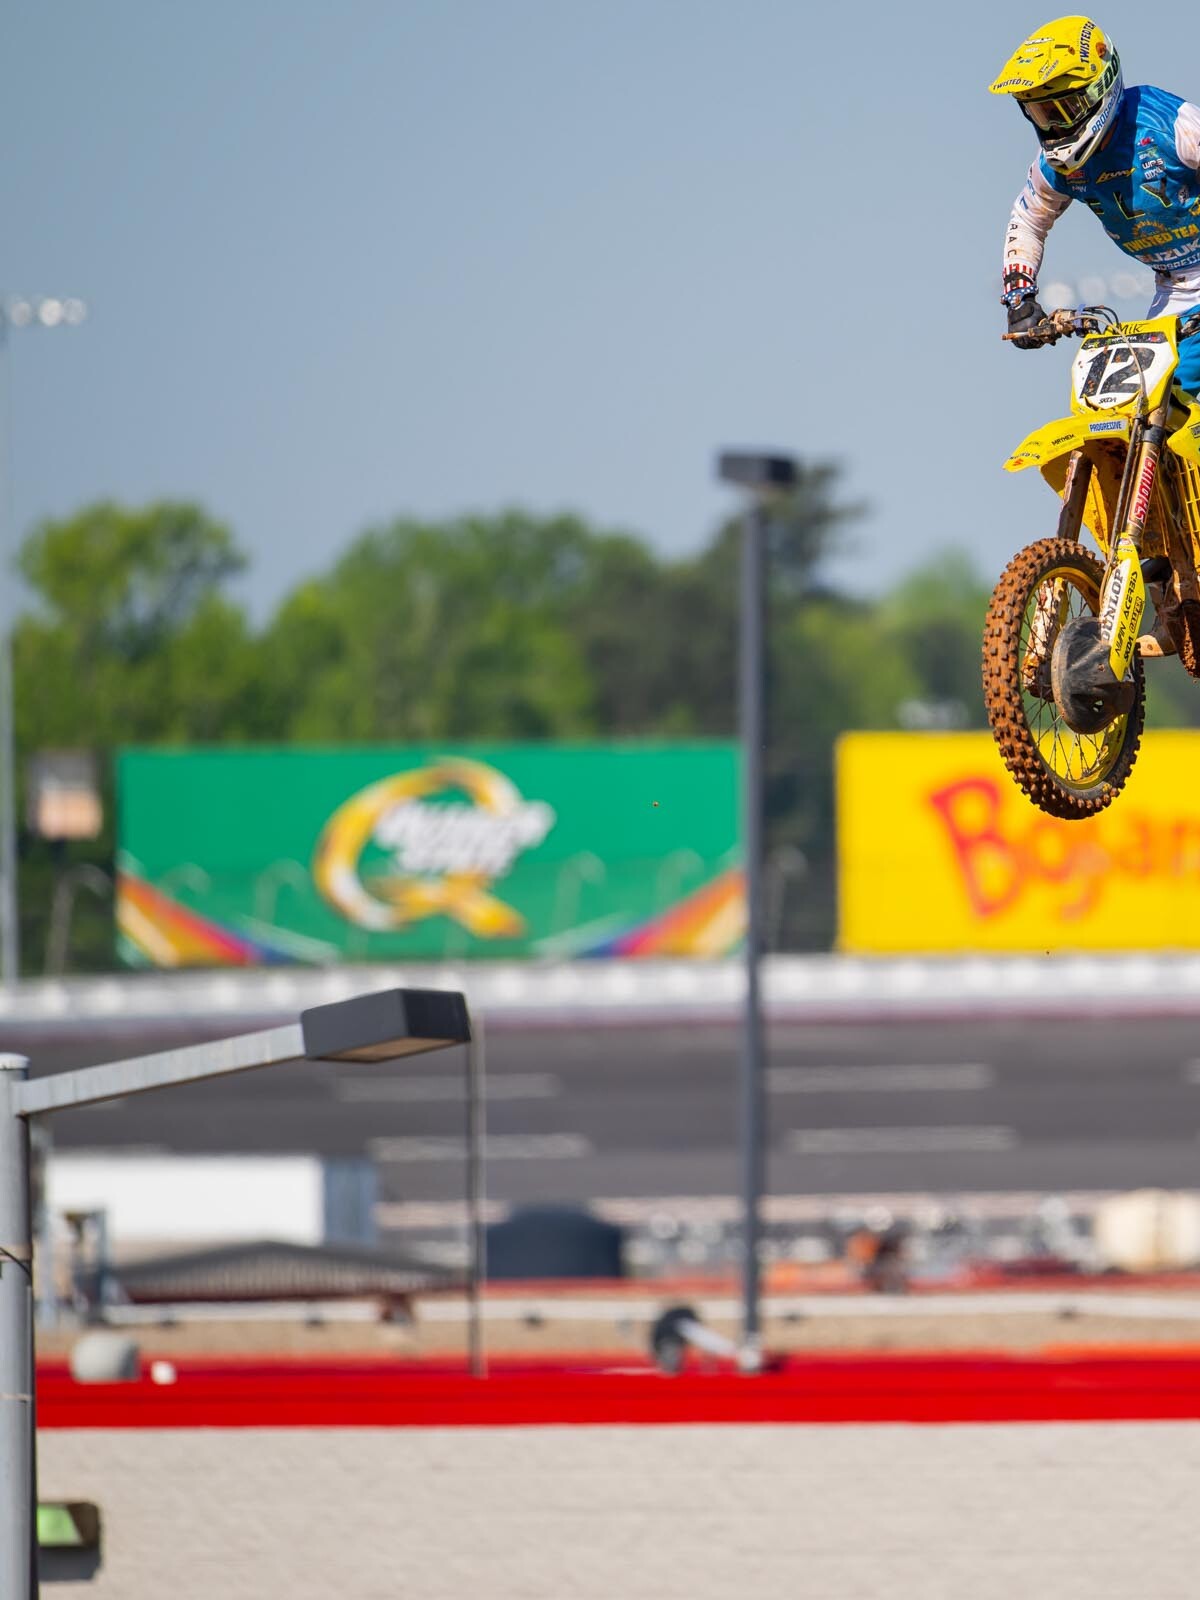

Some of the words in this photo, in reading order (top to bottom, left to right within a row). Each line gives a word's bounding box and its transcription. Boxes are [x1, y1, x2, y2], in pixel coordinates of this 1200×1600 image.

[1085, 20, 1097, 34] TEA
[1080, 29, 1092, 63] TWISTED
[993, 78, 1021, 91] TWISTED
[1021, 78, 1034, 87] TEA
[1094, 46, 1120, 98] 100
[1122, 232, 1174, 252] TWISTED
[1171, 223, 1200, 239] TEA
[1079, 347, 1156, 399] 12
[1089, 421, 1122, 432] PROGRESSIVE
[1134, 456, 1157, 523] SHOWA
[1101, 568, 1124, 642] DUNLOP
